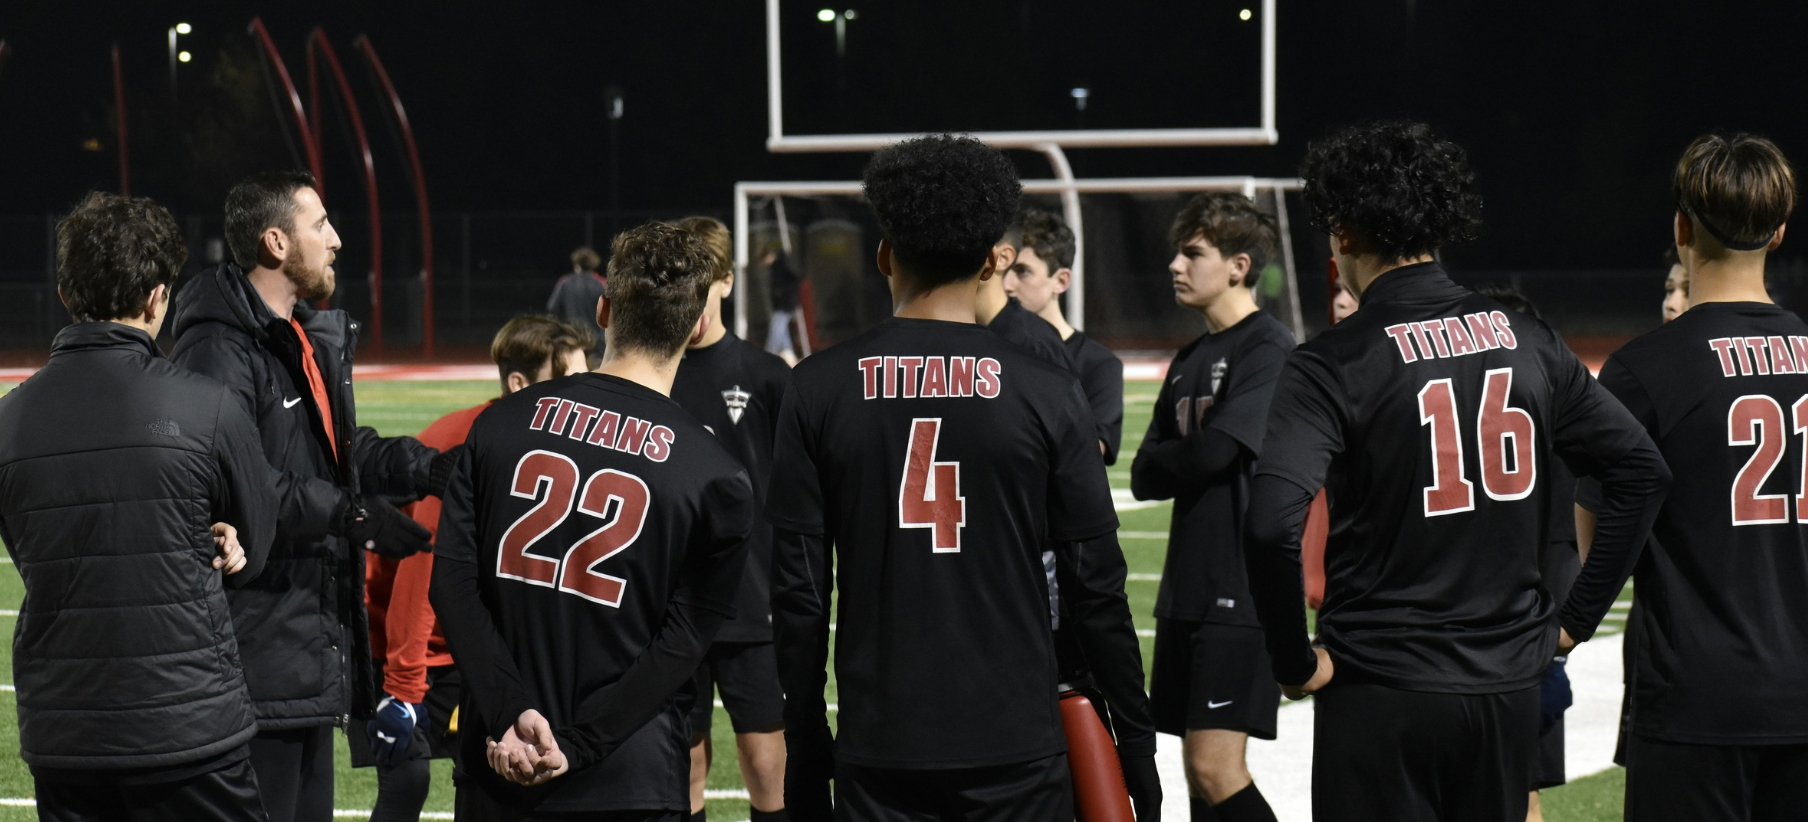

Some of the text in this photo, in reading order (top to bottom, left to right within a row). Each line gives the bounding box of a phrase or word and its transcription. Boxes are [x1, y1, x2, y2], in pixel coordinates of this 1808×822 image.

[858, 356, 1001, 400] TITANS
[1384, 310, 1518, 364] TITANS
[529, 396, 675, 463] TITANS
[1417, 367, 1536, 517] 16
[496, 449, 651, 609] 22
[899, 417, 966, 553] 4
